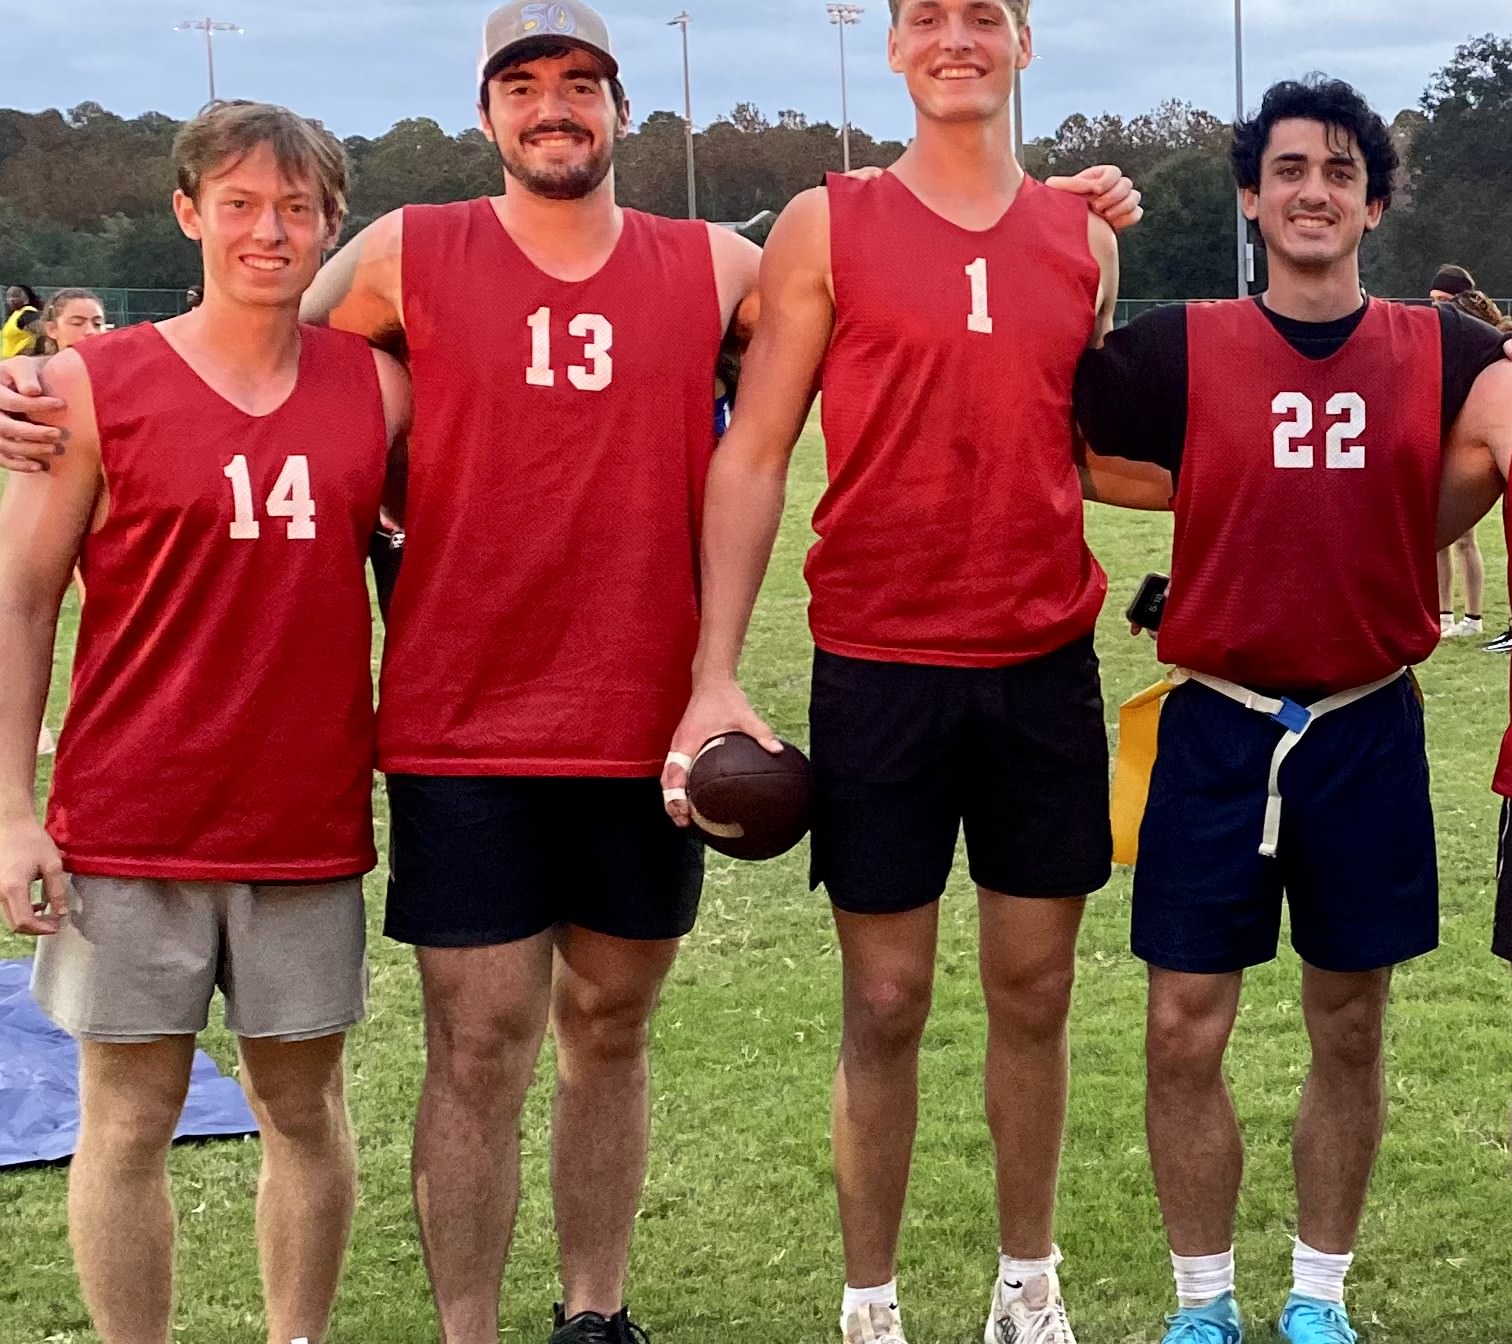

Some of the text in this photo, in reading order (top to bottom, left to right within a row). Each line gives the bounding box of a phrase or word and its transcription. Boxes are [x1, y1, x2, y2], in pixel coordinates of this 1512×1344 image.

[519, 2, 575, 34] 50
[963, 256, 994, 335] 1
[524, 305, 614, 392] 13
[1270, 390, 1367, 470] 22
[222, 453, 317, 541] 14
